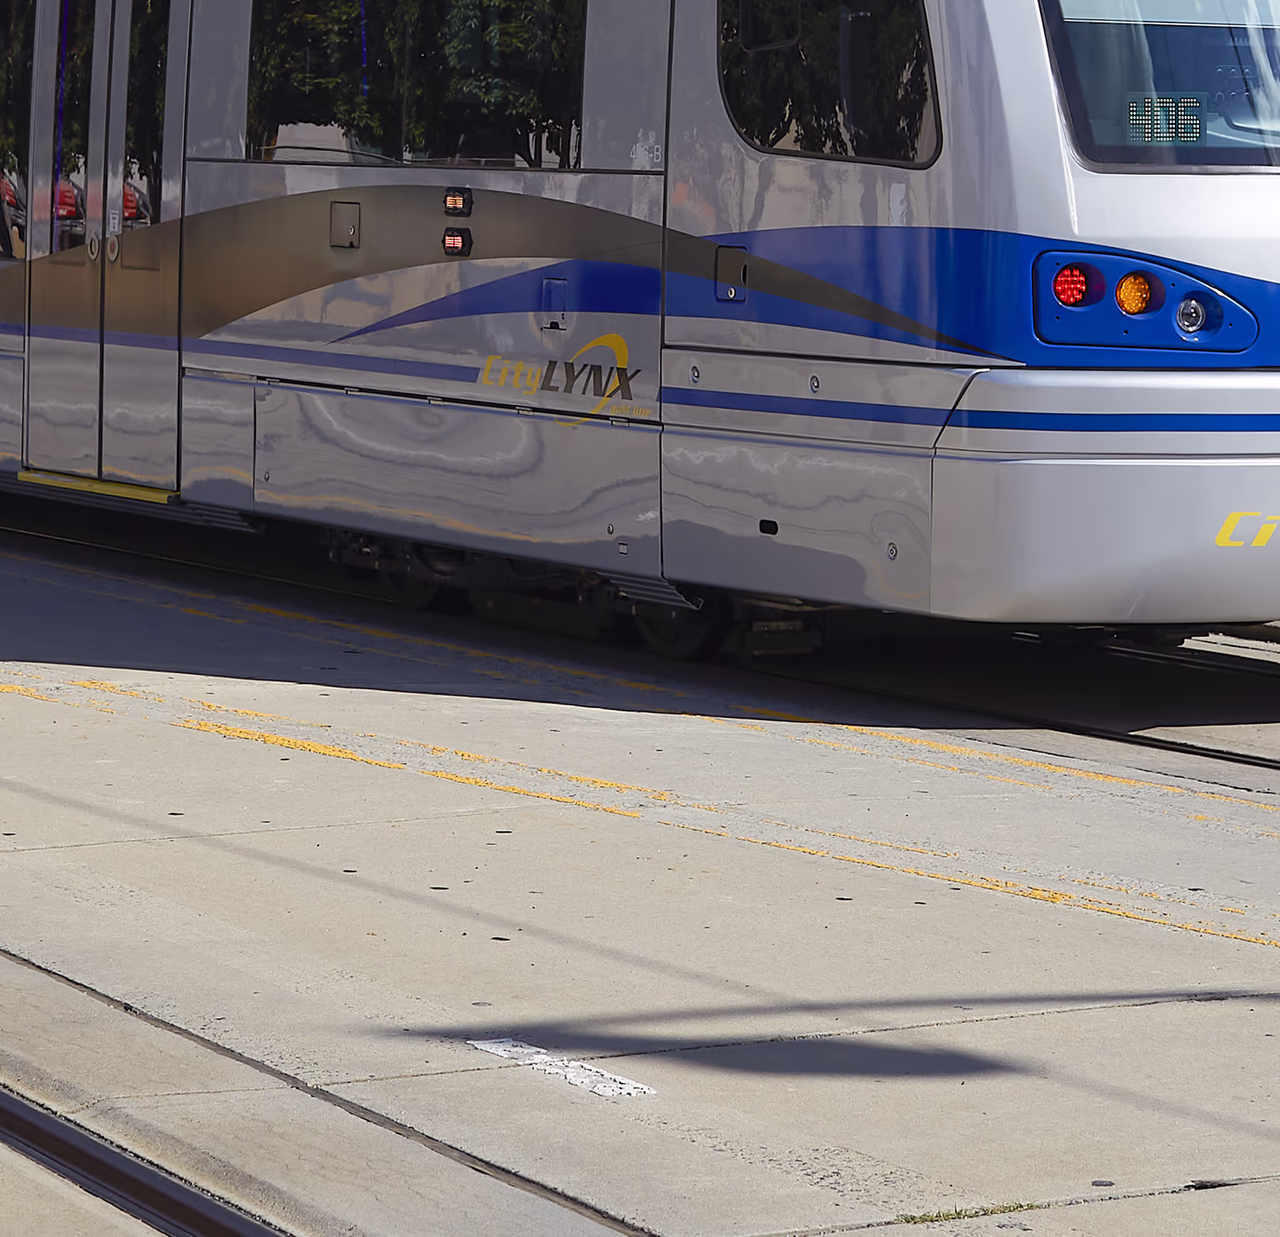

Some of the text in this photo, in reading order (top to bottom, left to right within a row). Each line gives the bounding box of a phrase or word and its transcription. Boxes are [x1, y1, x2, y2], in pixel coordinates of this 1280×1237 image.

[1129, 98, 1200, 142] 406
[629, 144, 661, 162] 46-B
[482, 355, 642, 400] CityLYNX
